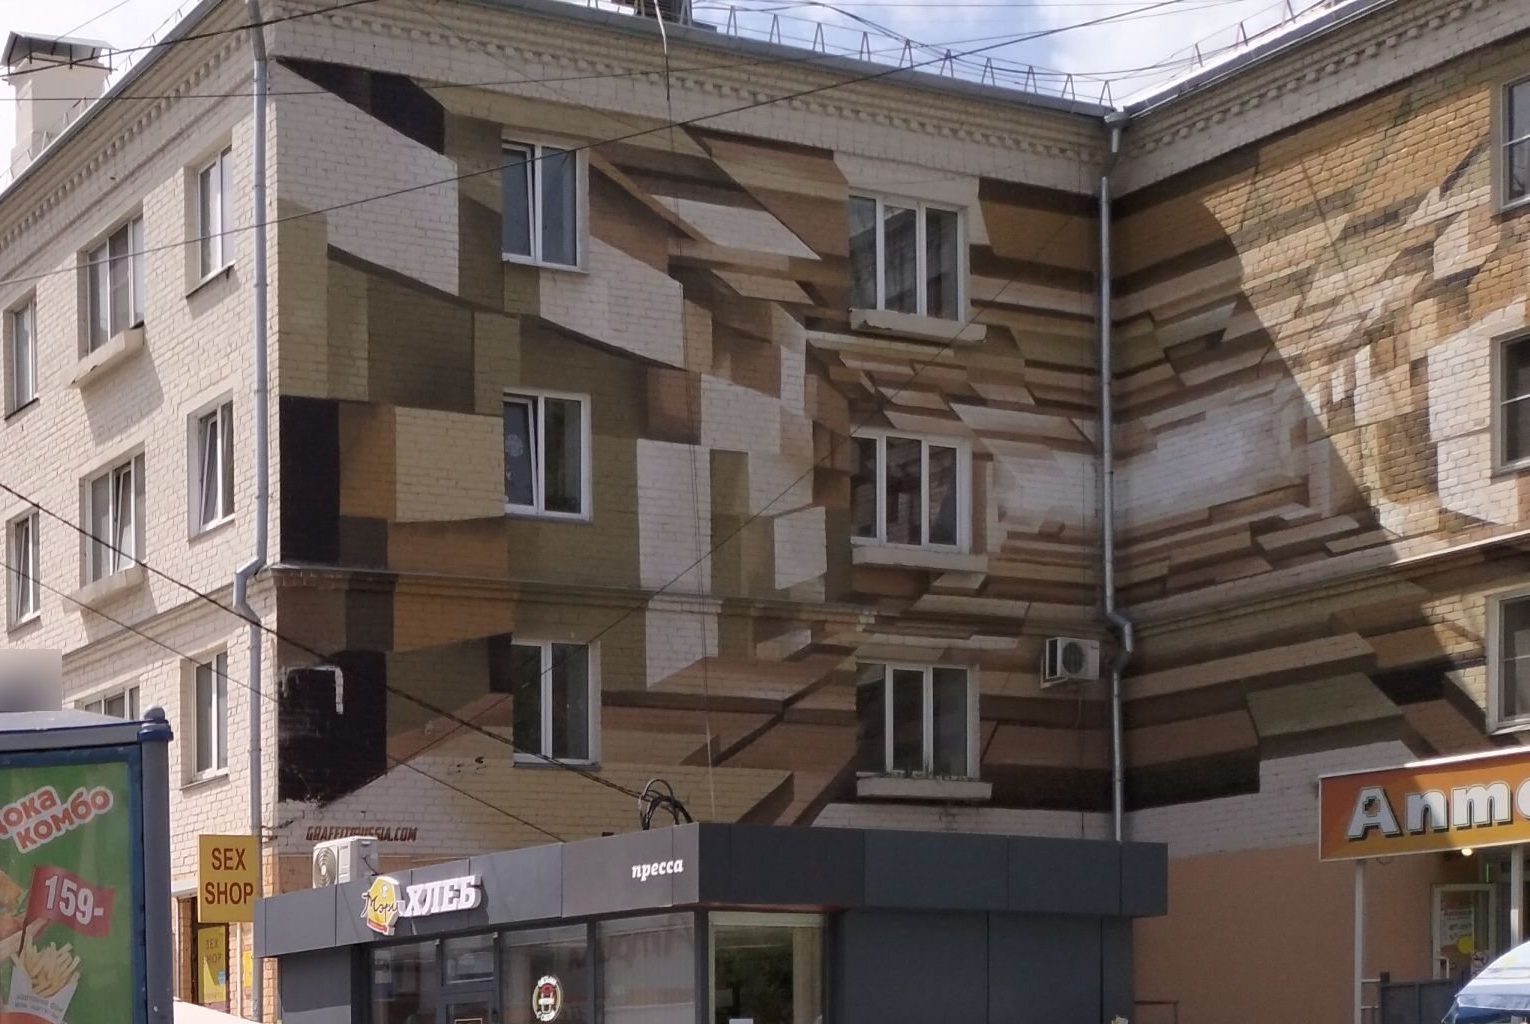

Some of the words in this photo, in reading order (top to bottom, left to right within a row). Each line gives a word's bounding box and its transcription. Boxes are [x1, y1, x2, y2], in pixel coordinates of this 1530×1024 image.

[15, 790, 111, 849] комбо
[211, 847, 246, 871] SEX
[631, 859, 684, 882] пресса
[204, 882, 254, 905] SHOP
[405, 875, 479, 917] ХЛЕБ
